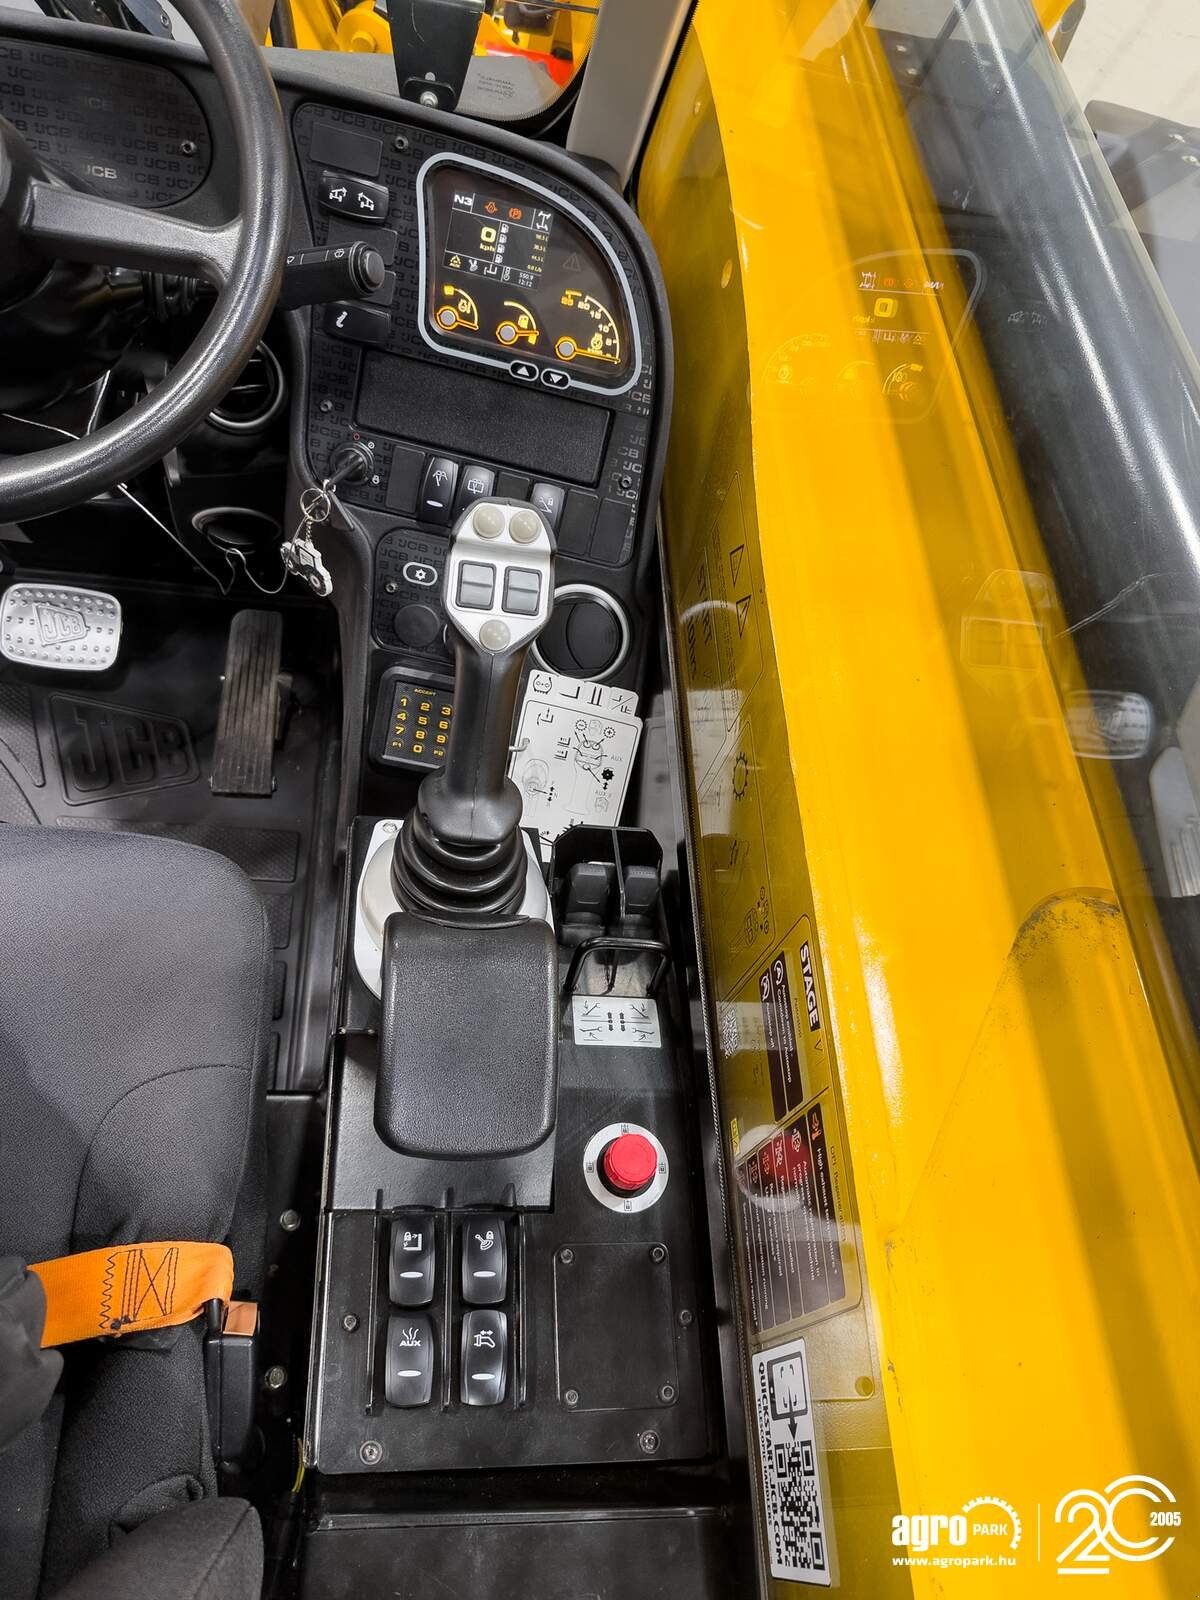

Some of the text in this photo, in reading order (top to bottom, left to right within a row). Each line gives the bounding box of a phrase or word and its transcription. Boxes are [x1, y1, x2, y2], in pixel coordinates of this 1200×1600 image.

[331, 111, 367, 128] JCB
[454, 194, 472, 206] N3
[480, 243, 495, 252] kph
[481, 226, 497, 243] 0
[398, 538, 428, 553] JCB
[41, 608, 84, 640] JCB
[397, 712, 448, 730] 4 5 6
[400, 698, 450, 716] 1 2 3
[68, 701, 190, 793] JCB
[396, 726, 446, 744] 7 8 9
[413, 744, 422, 752] 0
[800, 944, 818, 1027] STAGE
[777, 988, 785, 1033] Countdown
[802, 1160, 811, 1205] Automatic
[819, 1171, 827, 1206] exhaust
[779, 1175, 794, 1273] Regeneration cancelled
[774, 1239, 783, 1276] required
[806, 1242, 814, 1281] machine
[757, 1397, 772, 1525] TELESCOPIC HANDLERS
